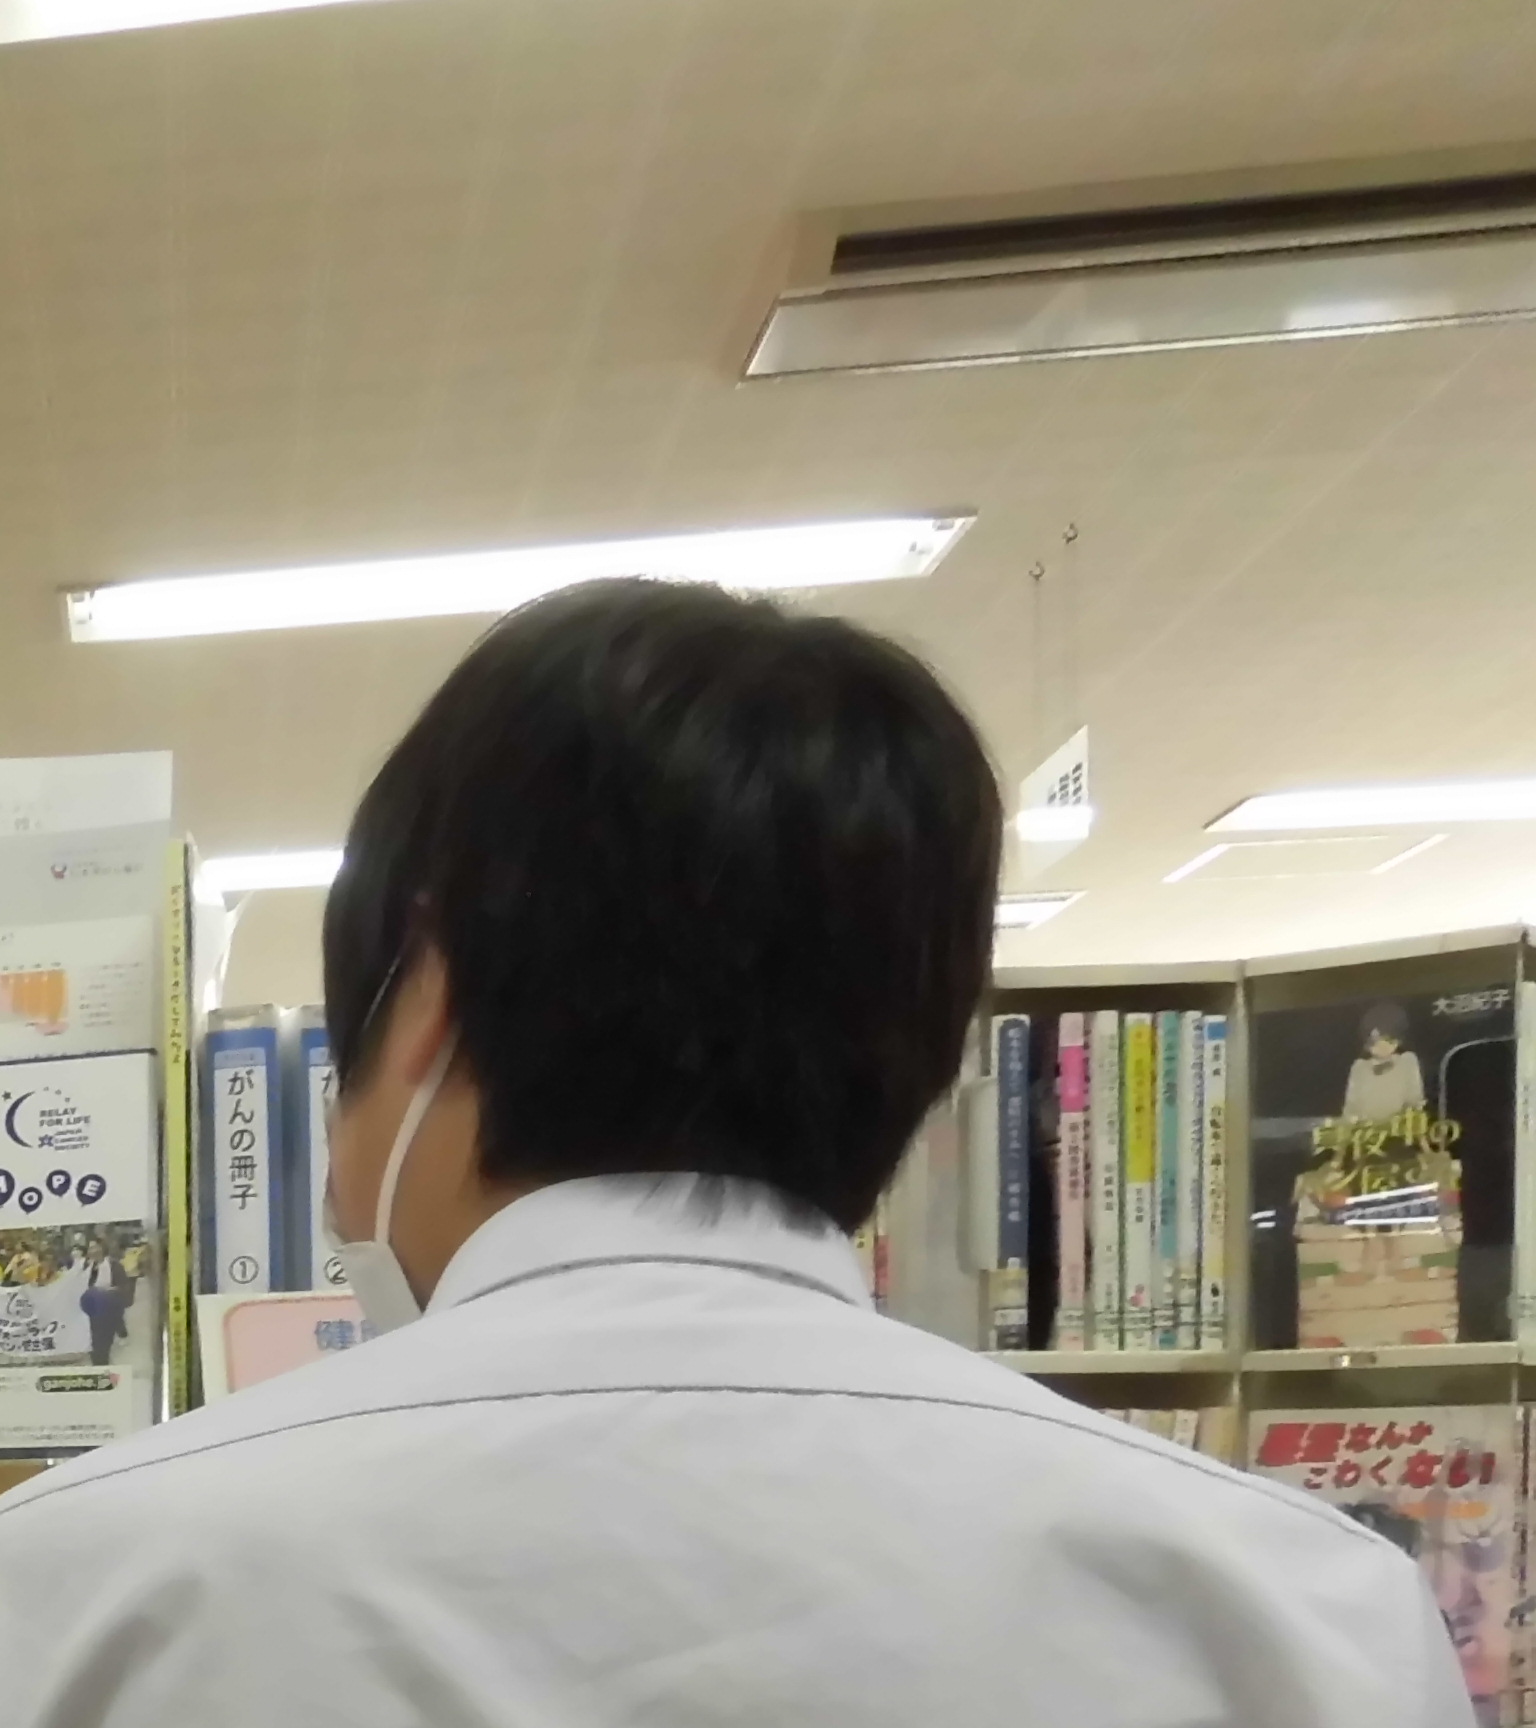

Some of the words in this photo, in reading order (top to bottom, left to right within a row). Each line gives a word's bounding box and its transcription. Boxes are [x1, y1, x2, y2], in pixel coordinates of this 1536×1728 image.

[39, 1107, 76, 1117] RELAY
[228, 1070, 257, 1210] がんの冊子
